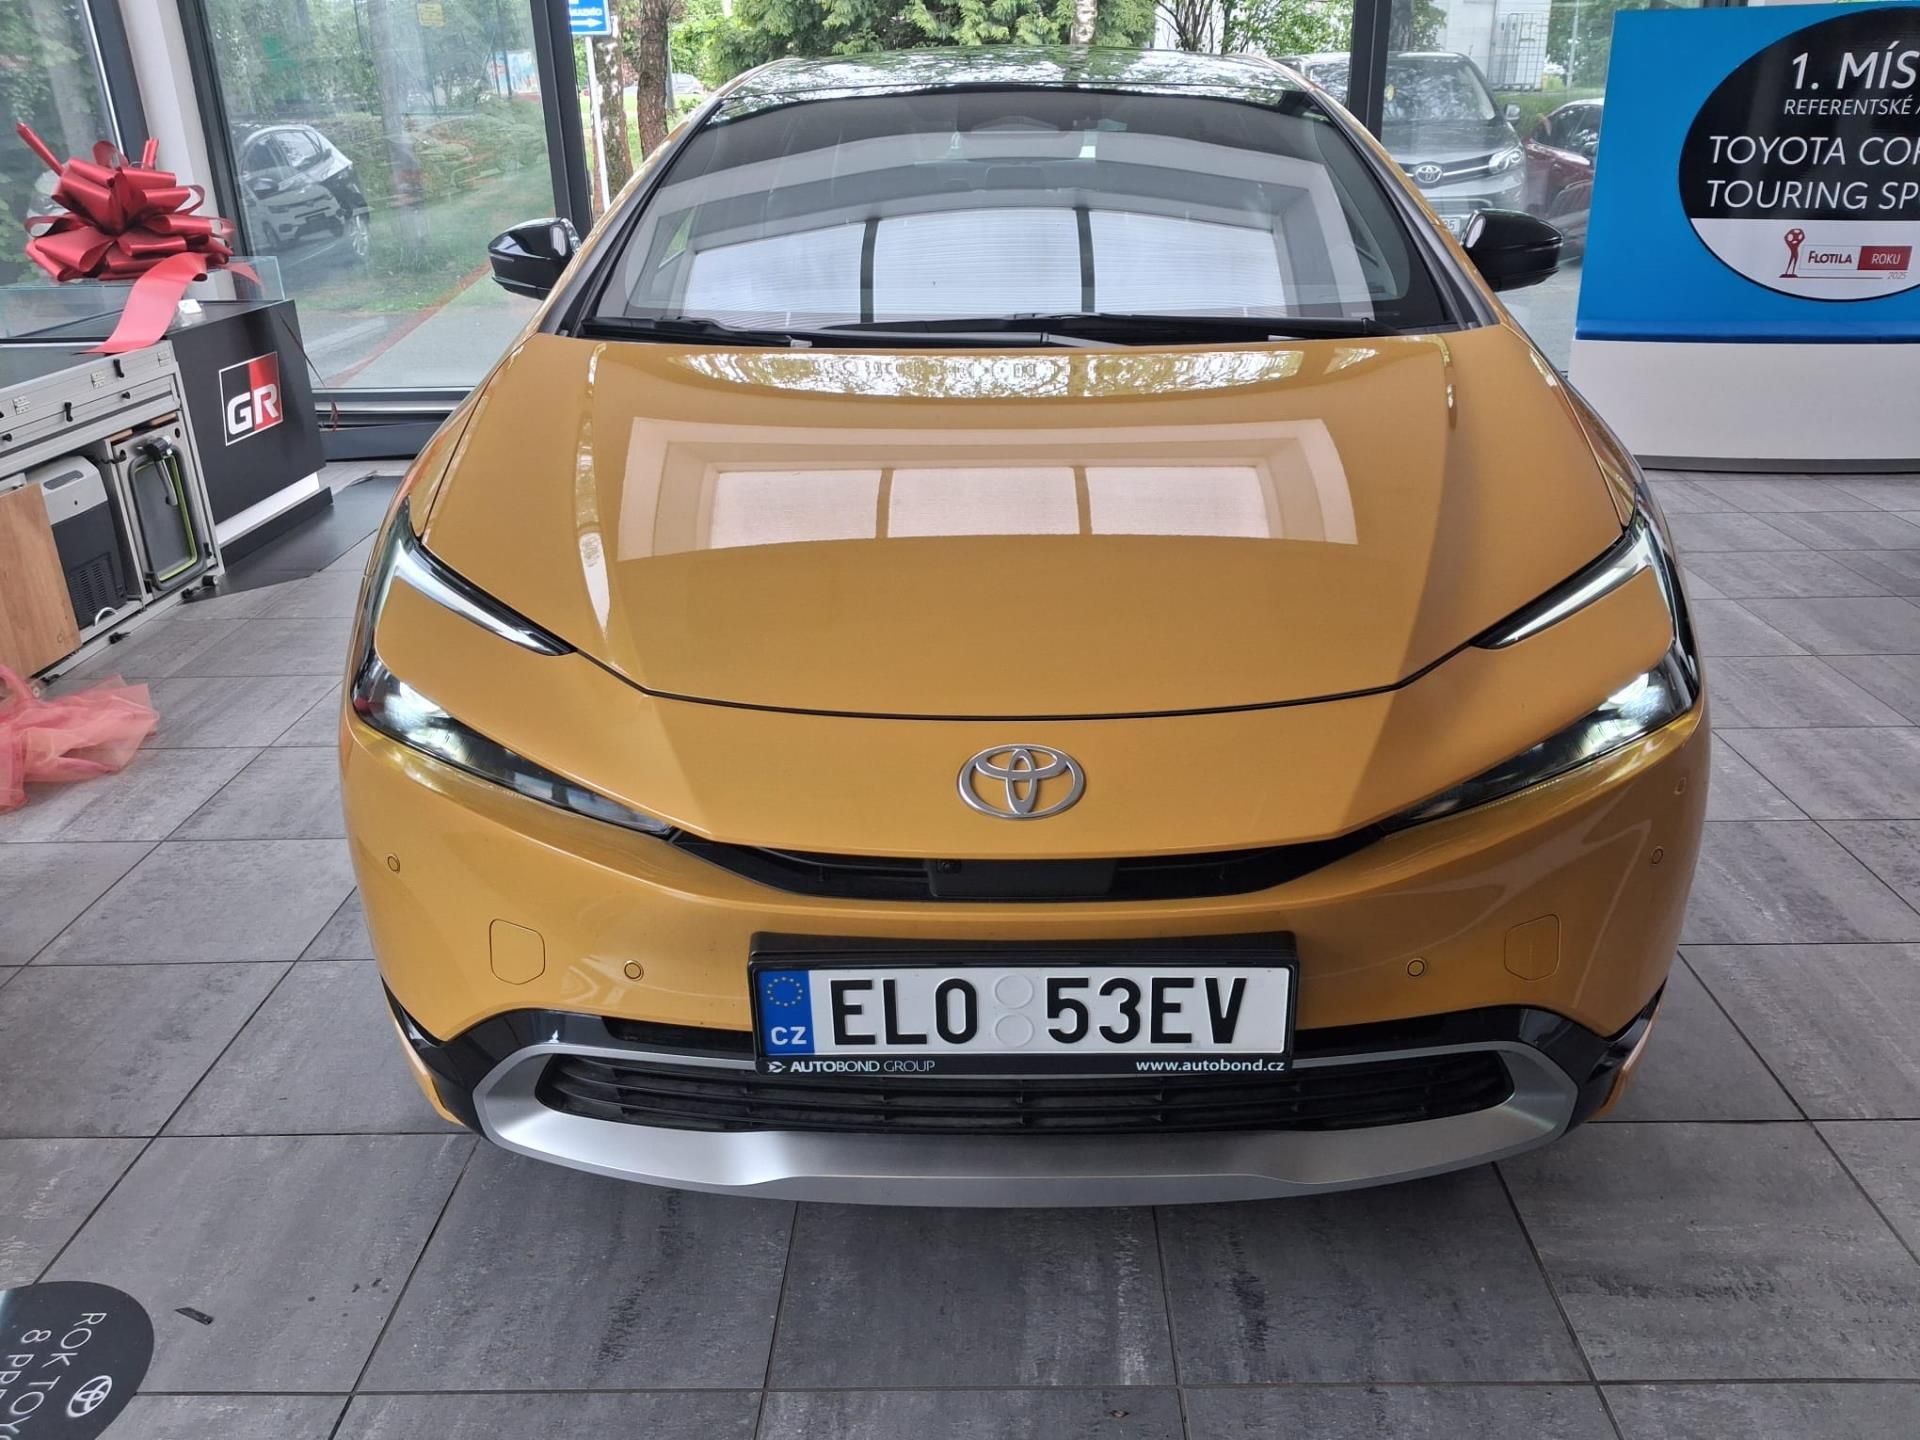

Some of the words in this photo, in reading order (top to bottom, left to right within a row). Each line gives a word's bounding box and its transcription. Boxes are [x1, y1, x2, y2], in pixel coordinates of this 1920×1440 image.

[1792, 52, 1819, 90] 1.
[1837, 41, 1920, 89] MÍS
[1784, 95, 1913, 115] REFERENTSKÉ
[1710, 135, 1846, 165] TOYOTA
[1707, 179, 1868, 209] TOURING
[1871, 253, 1901, 265] ROKU
[227, 384, 279, 434] GR
[1046, 977, 1248, 1045] 53EV
[770, 1026, 807, 1046] CZ
[790, 1061, 880, 1073] AUTOBOND
[883, 1060, 935, 1072] GROUP
[1136, 1059, 1285, 1072] www.autobond.cz
[41, 1312, 108, 1368] ROK
[0, 1375, 61, 1440] TOY
